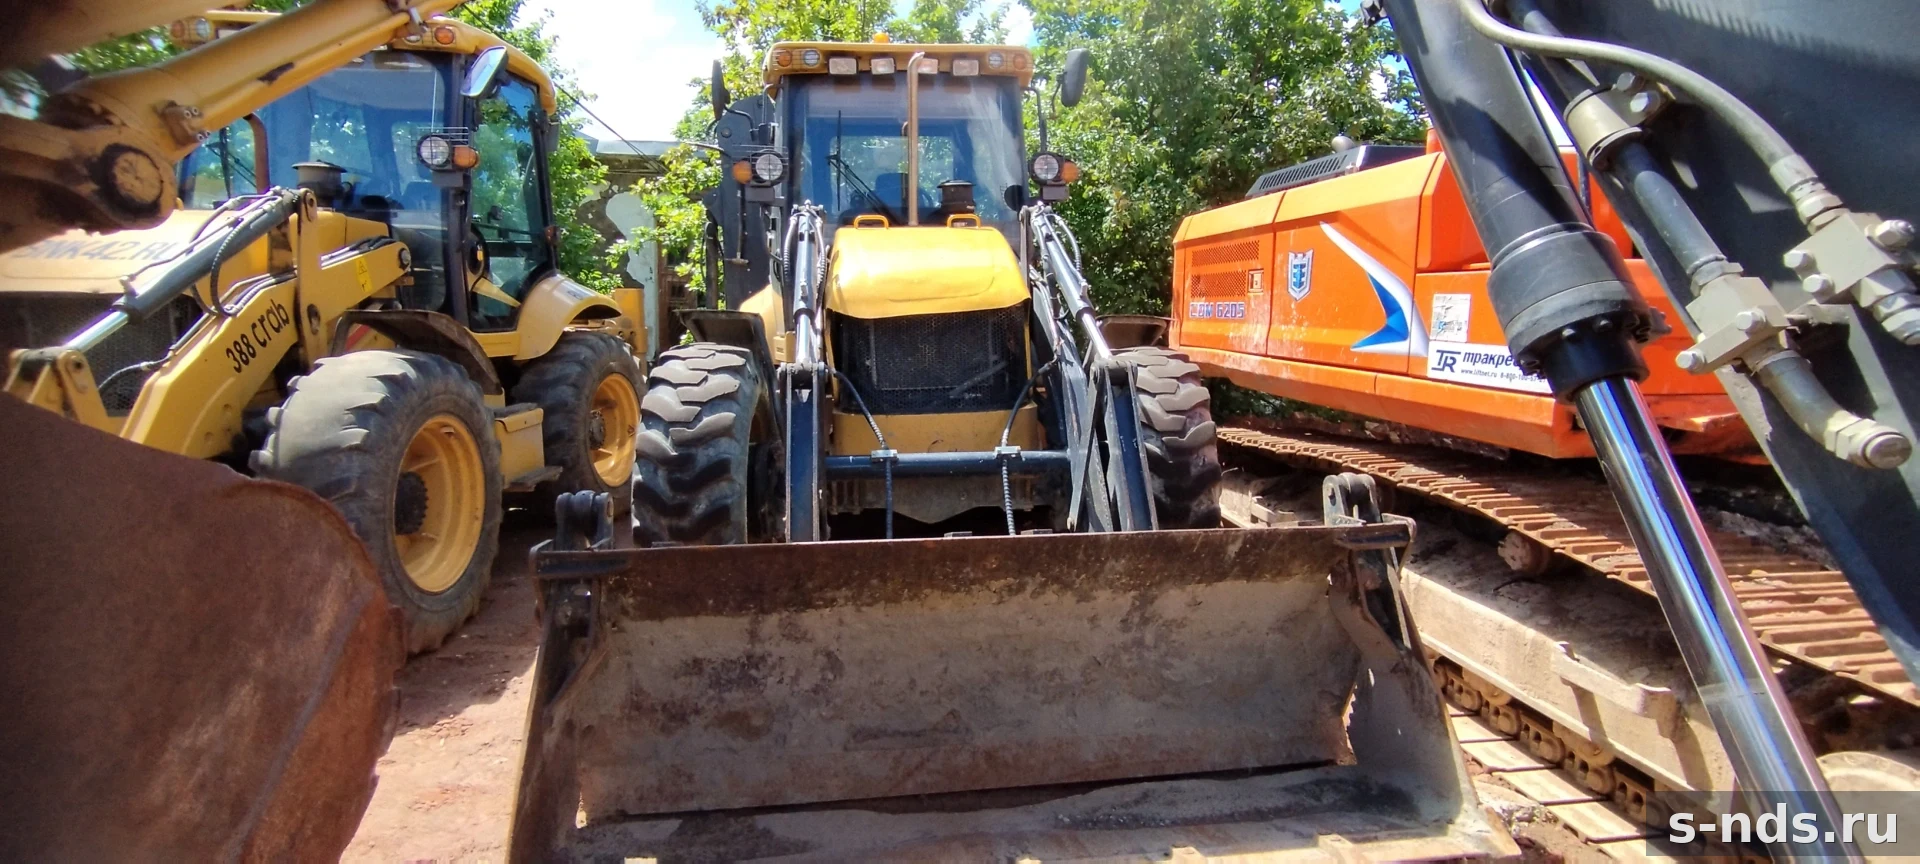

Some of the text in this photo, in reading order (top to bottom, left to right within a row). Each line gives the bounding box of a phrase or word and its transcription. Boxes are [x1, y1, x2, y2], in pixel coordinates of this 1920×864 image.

[1216, 302, 1245, 319] 6205
[226, 298, 290, 374] 388 crab
